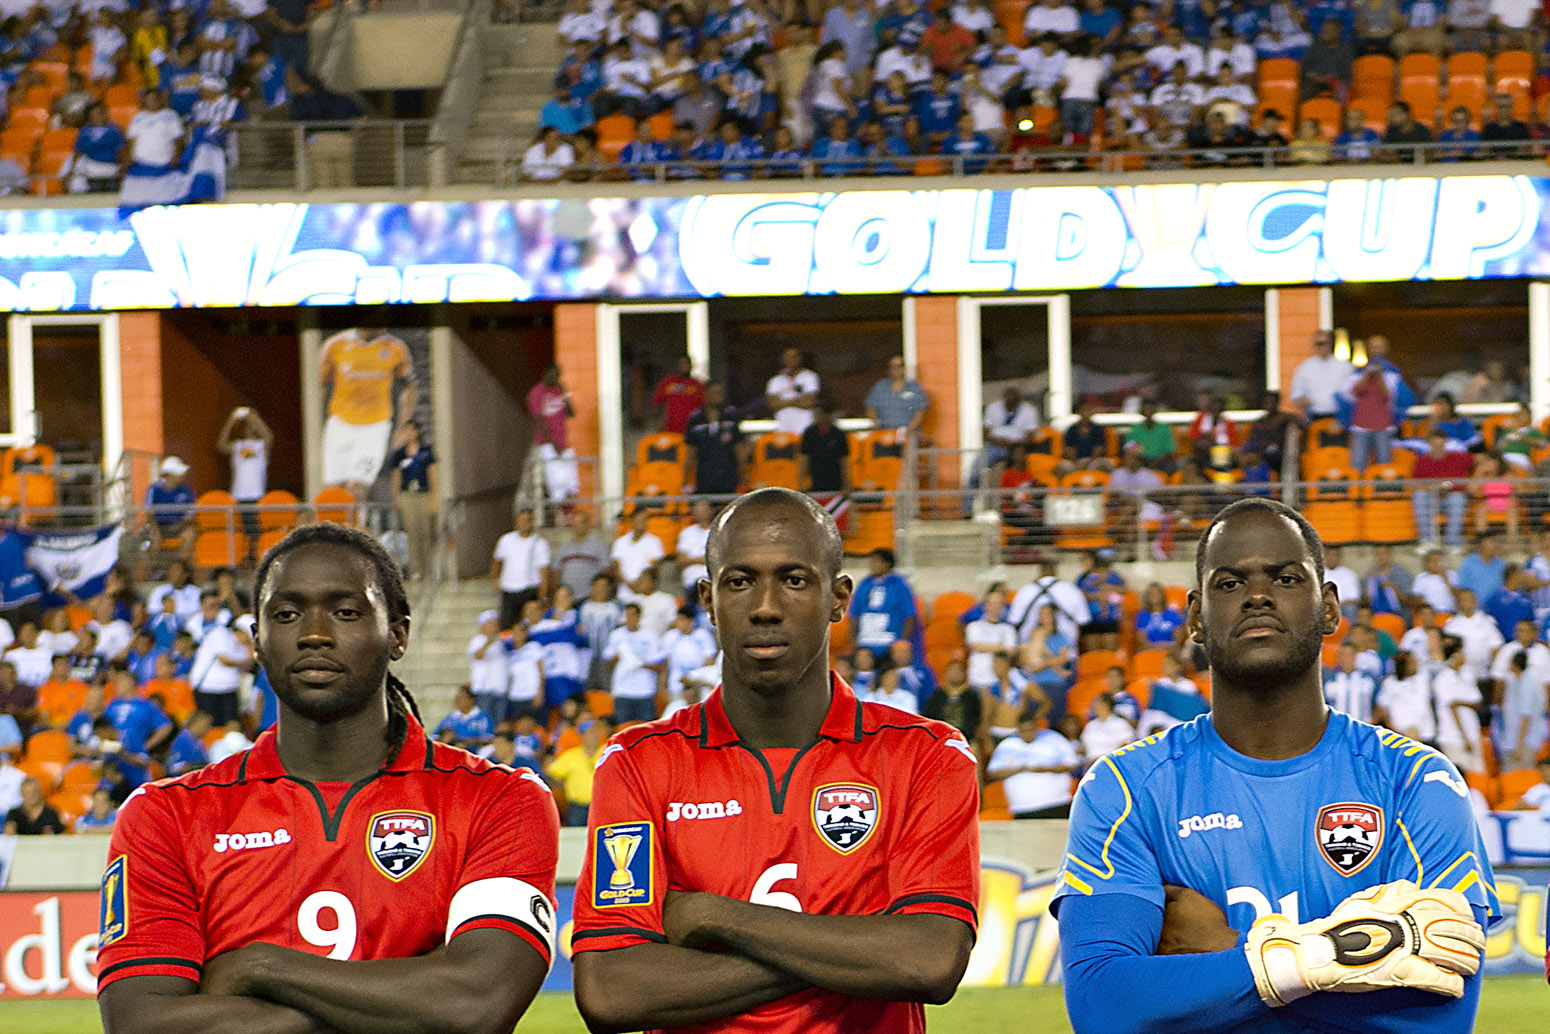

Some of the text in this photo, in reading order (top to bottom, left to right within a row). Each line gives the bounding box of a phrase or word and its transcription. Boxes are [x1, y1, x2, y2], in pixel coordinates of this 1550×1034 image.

[682, 176, 1540, 298] GOLD CUP
[824, 792, 870, 804] TTFA
[666, 799, 742, 822] Joma
[1327, 811, 1374, 824] TTFA
[380, 819, 426, 831] TTFA
[1178, 812, 1243, 838] Joma
[213, 827, 292, 853] Joma
[297, 890, 357, 961] 9
